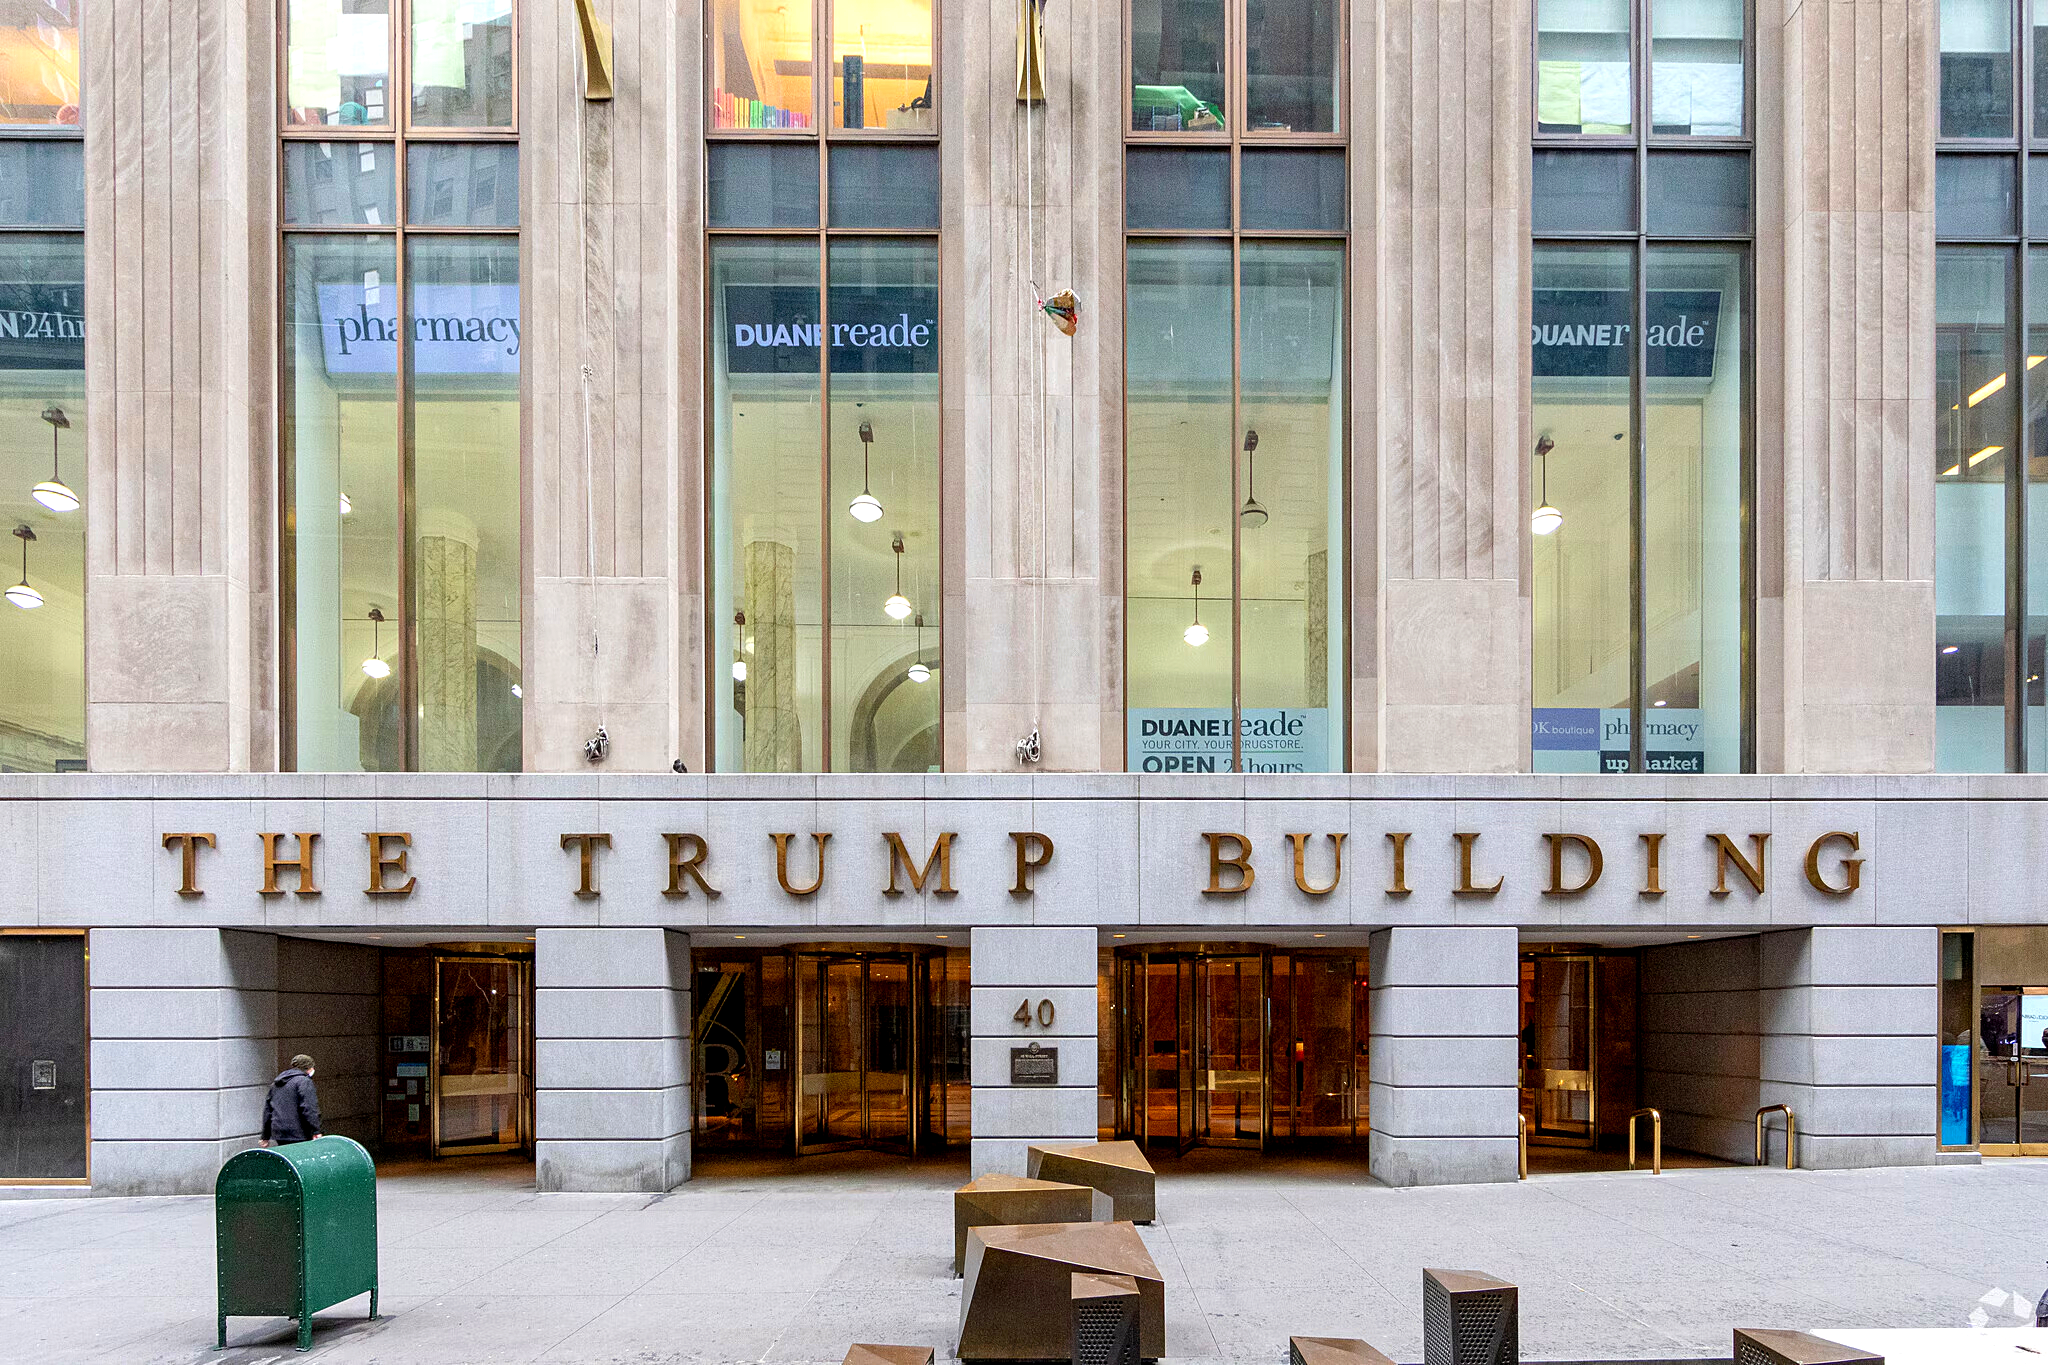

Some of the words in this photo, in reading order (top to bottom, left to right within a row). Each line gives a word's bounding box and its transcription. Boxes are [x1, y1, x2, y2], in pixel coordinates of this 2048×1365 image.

[1551, 725, 1595, 736] boutique
[1604, 718, 1699, 741] phmacy
[1142, 740, 1171, 750] YOUR
[1174, 740, 1200, 751] CITY.
[1204, 740, 1233, 750] YOUR
[1142, 756, 1215, 773] OPEN
[1248, 758, 1304, 773] hours
[1646, 756, 1698, 771] arket
[162, 831, 416, 896] THE
[560, 831, 1055, 896] TRUMP
[1201, 830, 1867, 896] BUILDING
[1013, 998, 1055, 1027] 40
